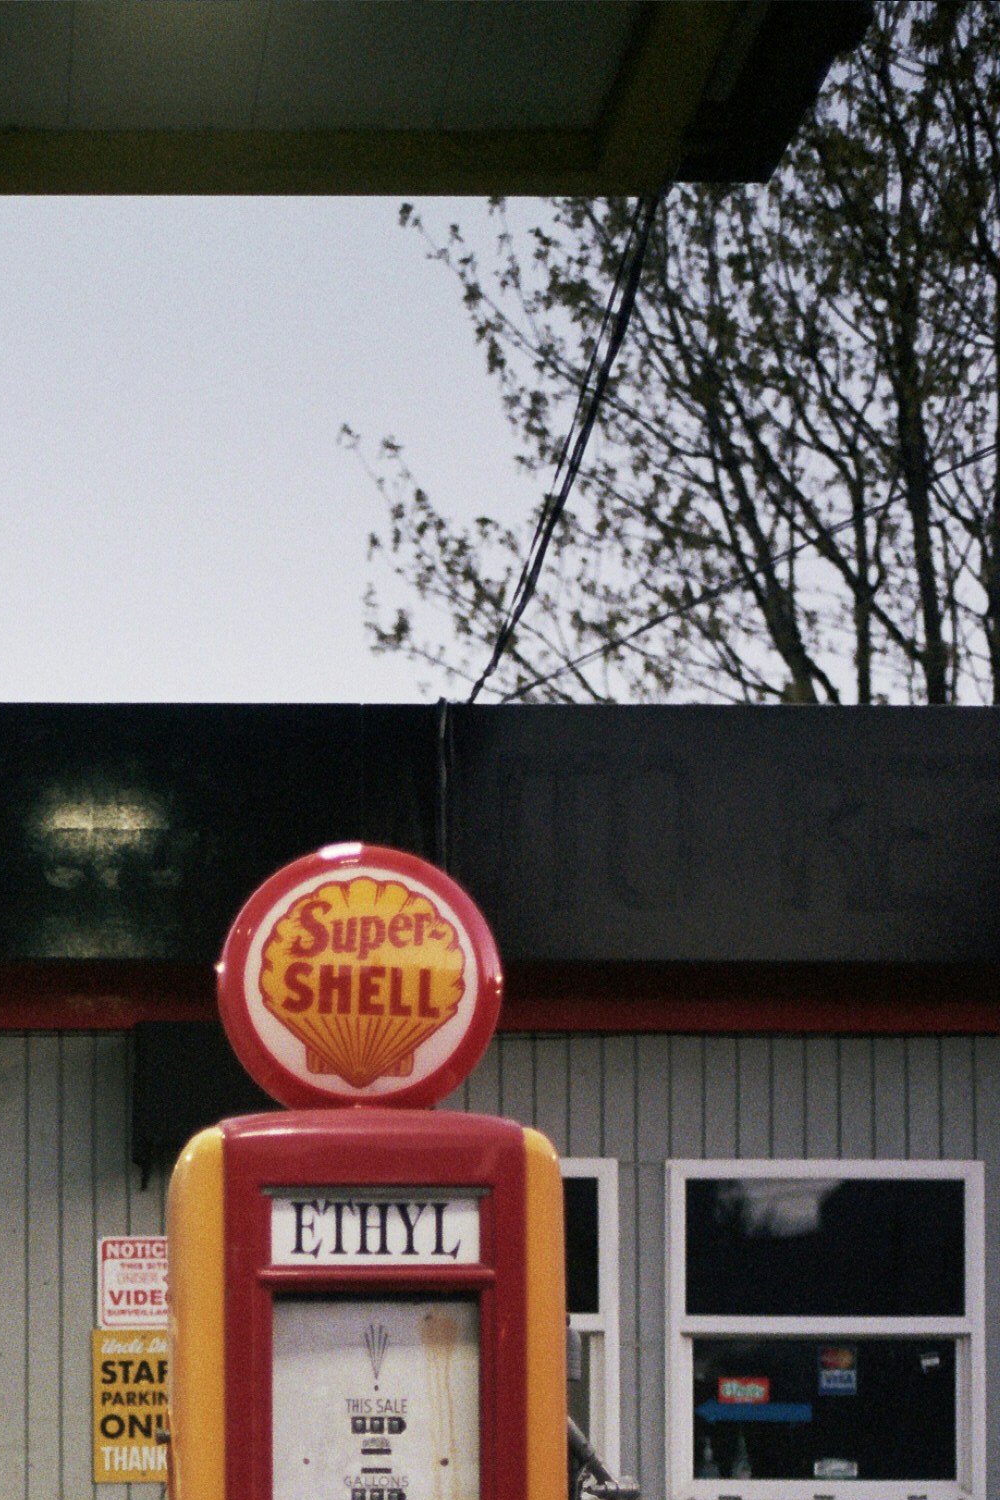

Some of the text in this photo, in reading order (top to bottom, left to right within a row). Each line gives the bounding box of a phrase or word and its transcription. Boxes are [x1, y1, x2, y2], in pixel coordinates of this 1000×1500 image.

[281, 962, 440, 1018] SHELL
[290, 1200, 462, 1259] ETHYL
[106, 1243, 168, 1258] NOTIC
[101, 1360, 168, 1385] STAF
[101, 1392, 168, 1407] PARKIN
[345, 1399, 408, 1414] THIS SALE
[101, 1446, 168, 1472] THANK
[343, 1475, 409, 1488] GALLONS
